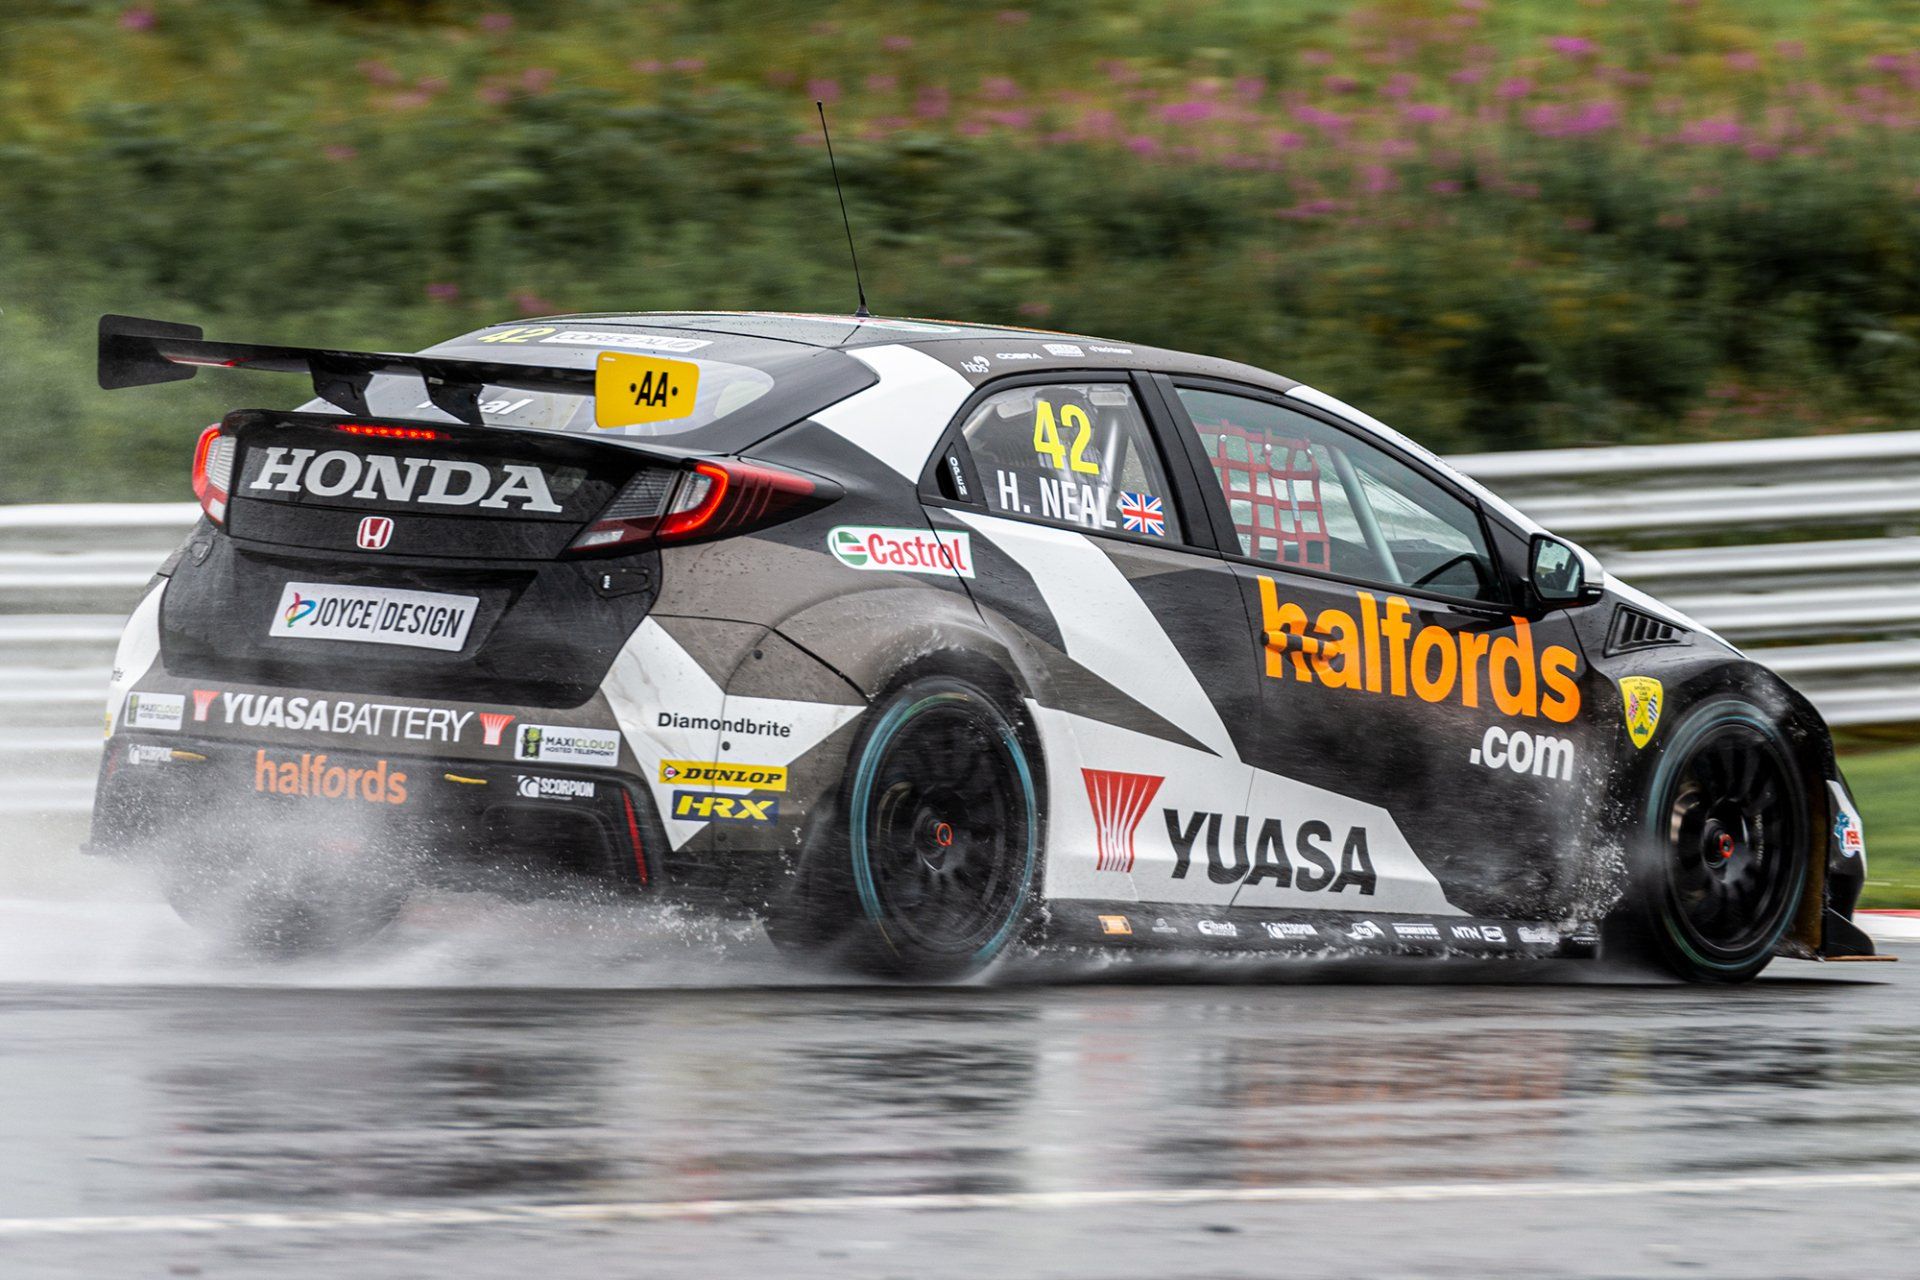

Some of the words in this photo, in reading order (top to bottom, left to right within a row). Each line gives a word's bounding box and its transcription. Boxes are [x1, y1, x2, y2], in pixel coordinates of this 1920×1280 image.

[477, 327, 557, 343] 42
[1033, 400, 1100, 475] 42
[249, 447, 564, 513] HONDA
[950, 456, 968, 496] OPEN
[997, 469, 1032, 514] H.
[1039, 476, 1117, 528] NEAL
[867, 533, 967, 571] Castrol
[1256, 575, 1581, 723] halfords
[545, 737, 616, 751] MAXICLOUD
[657, 712, 791, 738] Diamondbrite
[1470, 726, 1575, 781] .com
[255, 749, 408, 804] halfords
[540, 777, 595, 798] SCORPION
[682, 767, 783, 785] DUNLOP
[675, 795, 775, 820] HRX
[1163, 808, 1377, 895] YUASA
[1450, 926, 1482, 940] NTN
